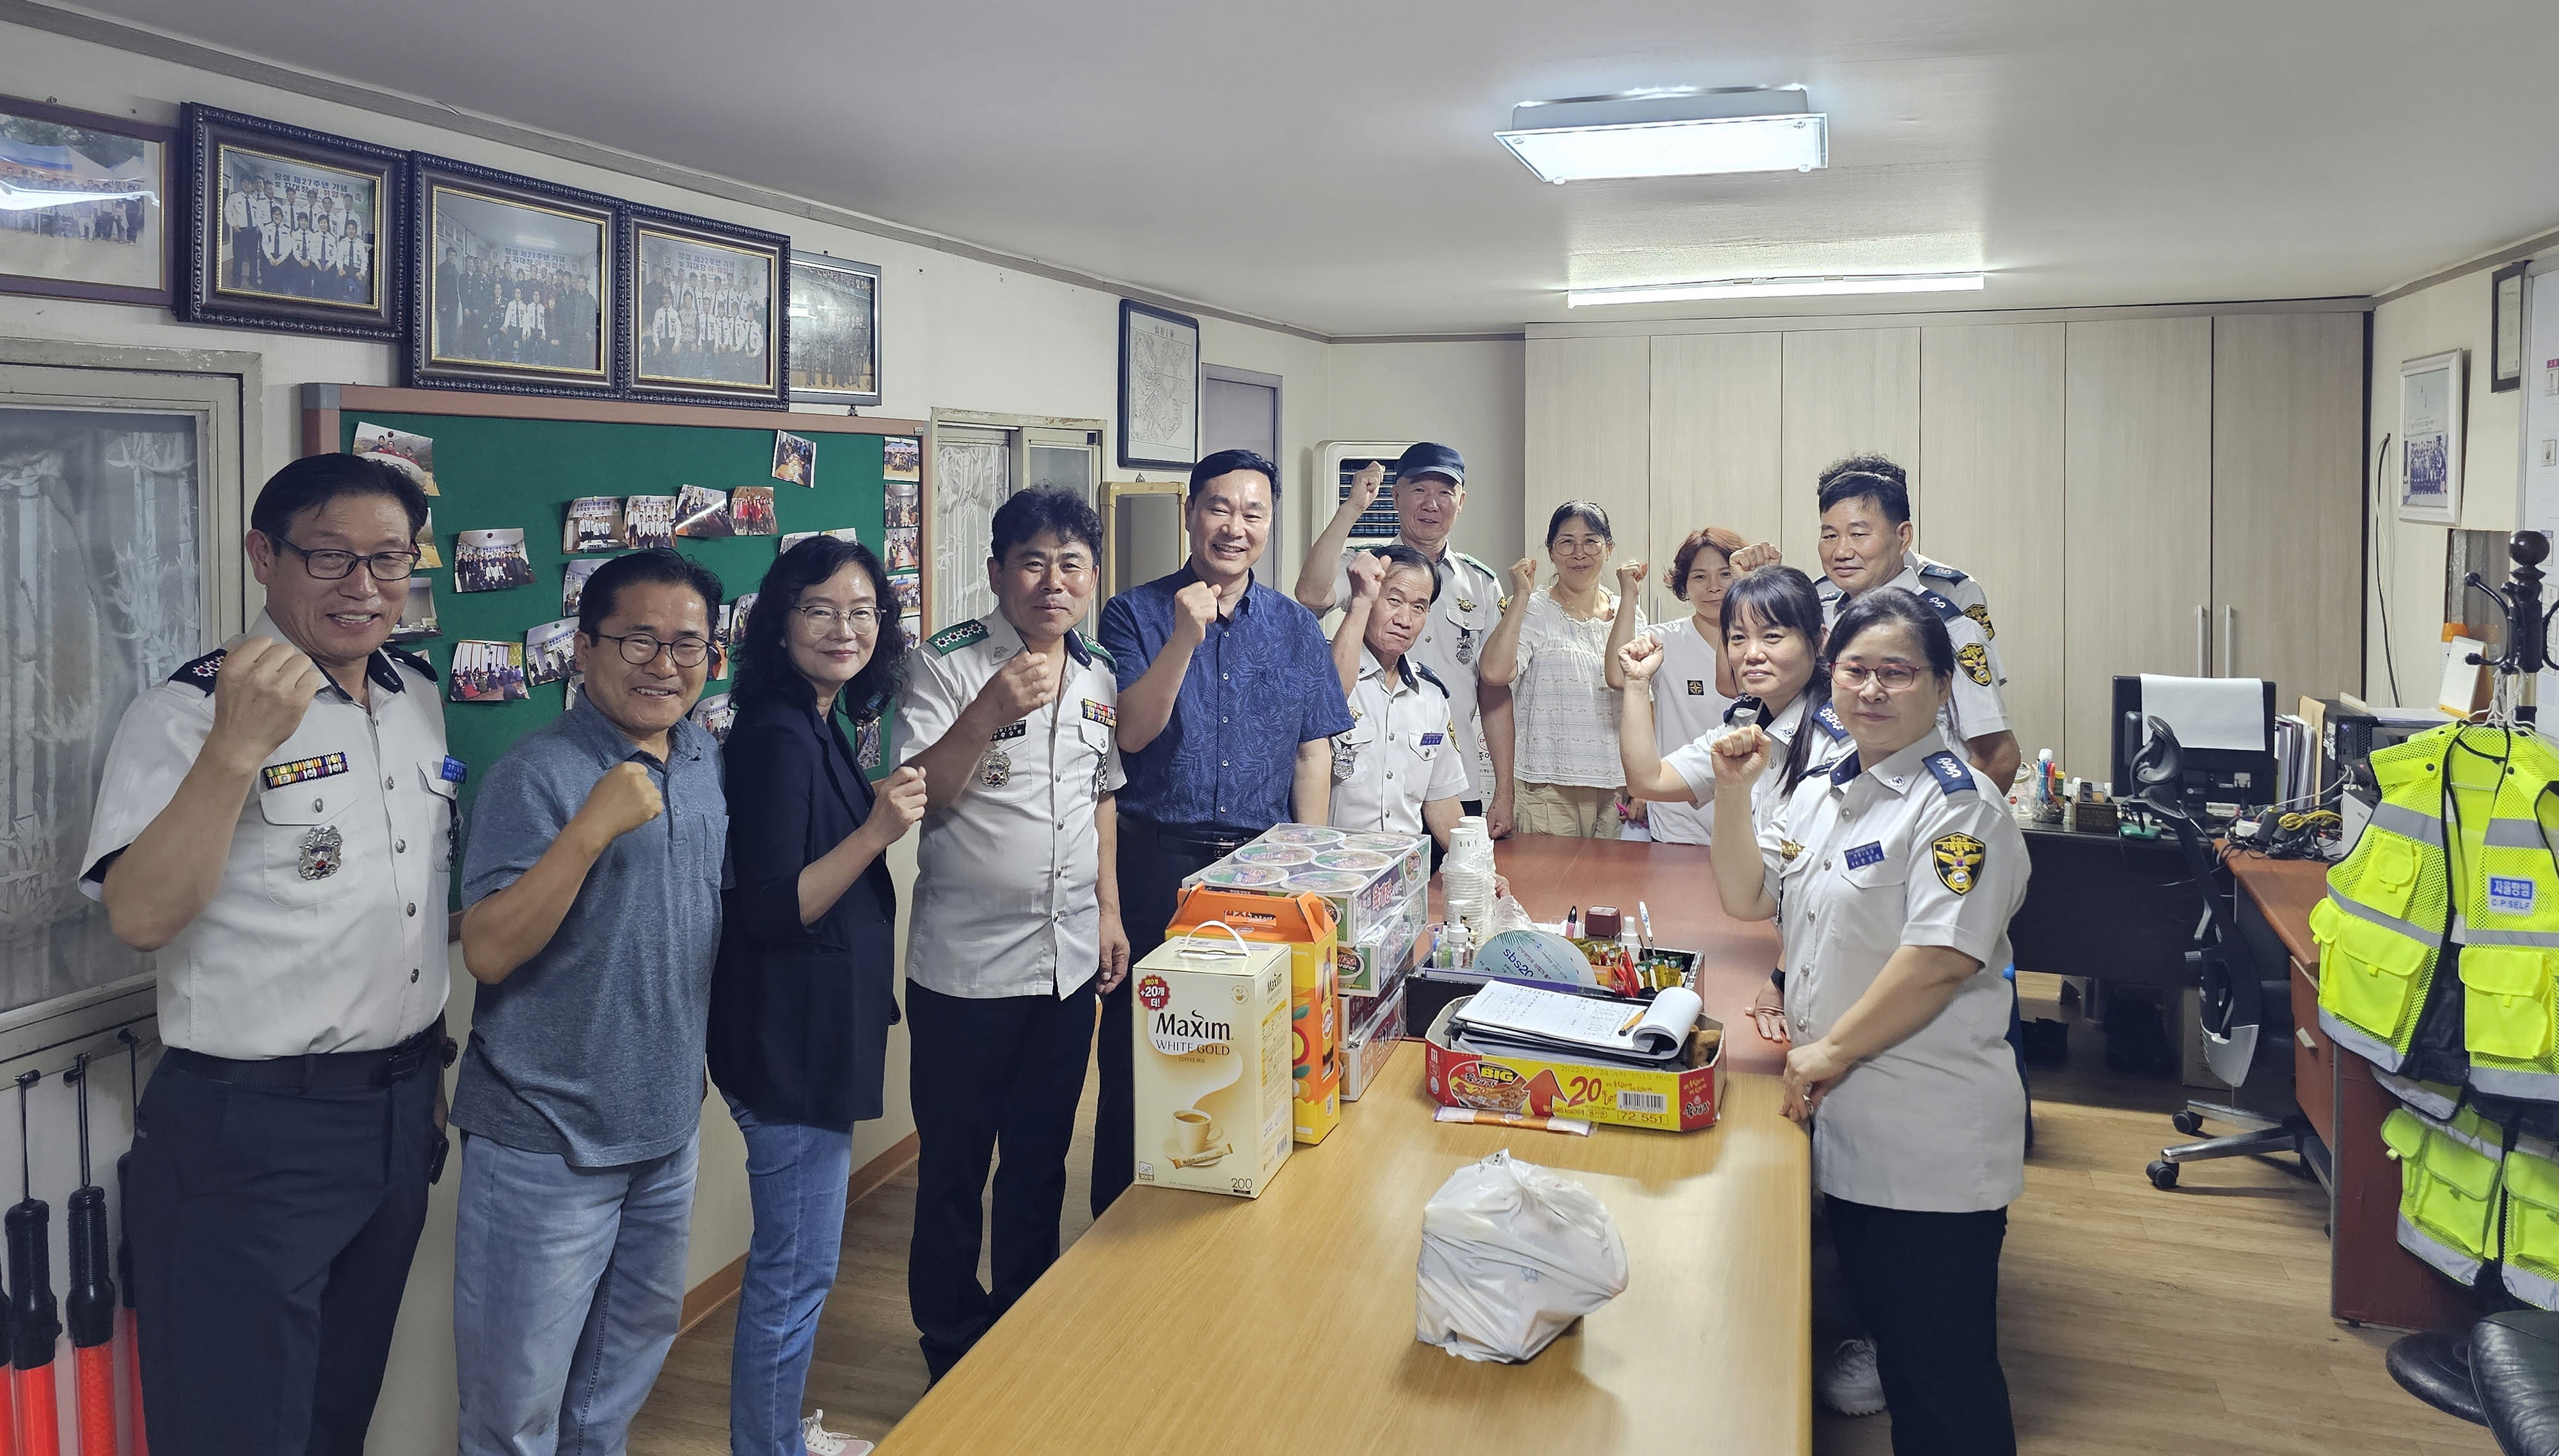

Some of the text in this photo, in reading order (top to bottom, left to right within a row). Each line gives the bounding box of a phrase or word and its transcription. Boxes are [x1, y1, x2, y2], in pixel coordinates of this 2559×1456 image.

[294, 176, 329, 189] 제27주년
[331, 182, 348, 193] 기념
[2494, 880, 2530, 897] 자율방범
[1140, 986, 1165, 997] +20개
[1267, 972, 1282, 994] Maxim
[1150, 998, 1161, 1008] 더!
[1155, 1009, 1230, 1040] Maxim
[1155, 1039, 1230, 1056] WHITE GOLD
[1481, 1067, 1514, 1082] BIG
[1567, 1075, 1602, 1108] 20
[1620, 1112, 1663, 1123] 72 551
[1231, 1178, 1253, 1190] 200
